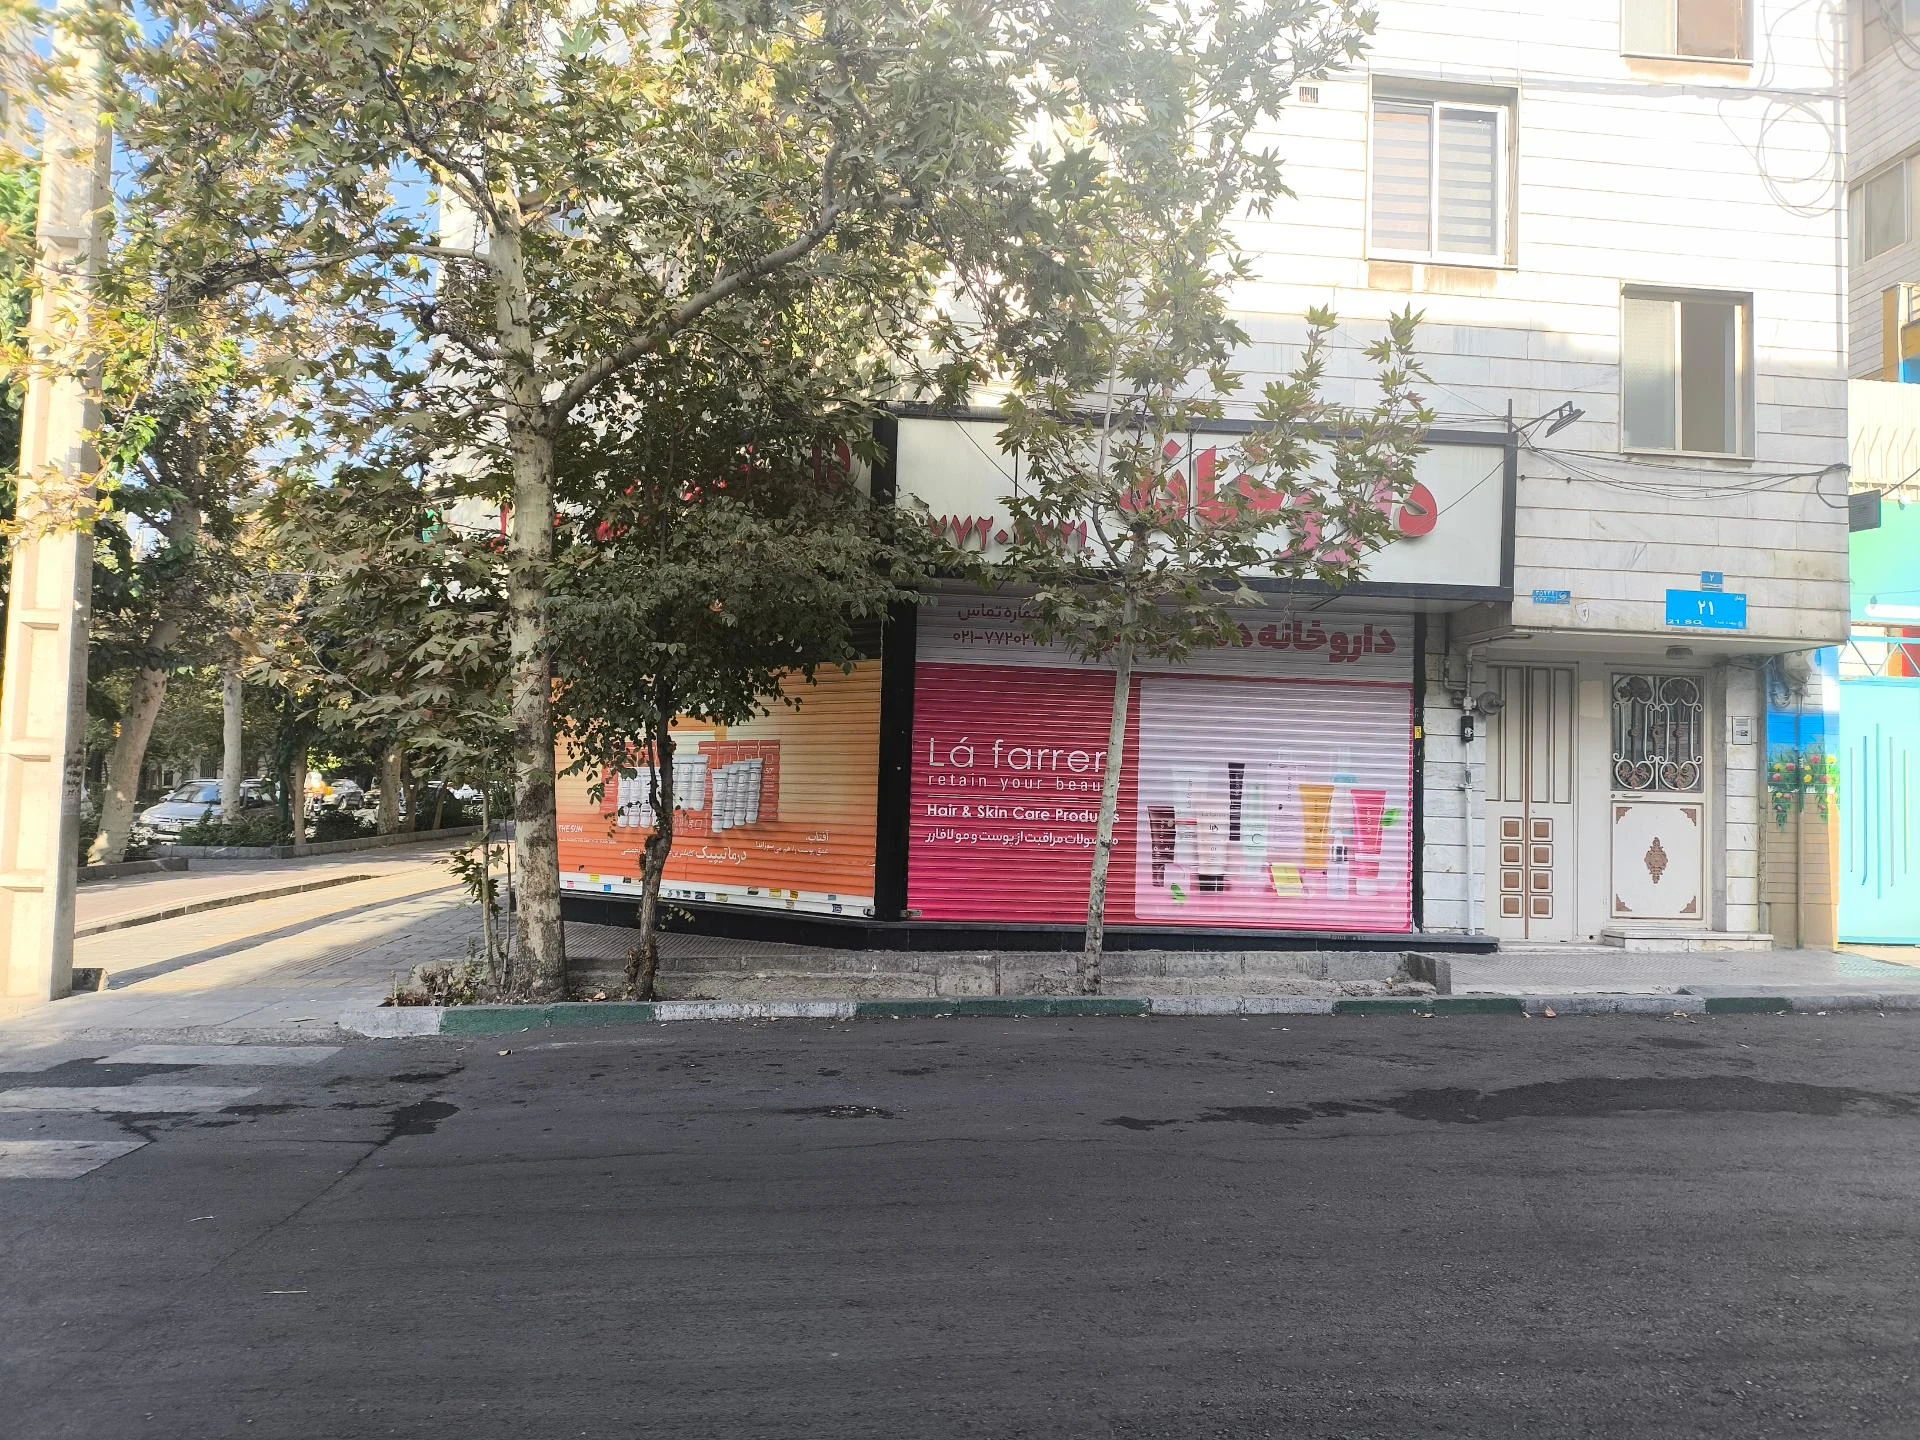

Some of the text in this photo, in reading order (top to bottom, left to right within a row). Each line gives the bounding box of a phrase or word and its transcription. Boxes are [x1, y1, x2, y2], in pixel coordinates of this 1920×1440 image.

[958, 604, 1002, 621] تماس
[1697, 599, 1714, 616] ۲۱
[953, 629, 1053, 647] ۰۲۱-۷۷۲۰۲۷۱
[1258, 618, 1397, 663] داروخانه
[929, 736, 975, 768] Lá
[928, 773, 1120, 793] retain your beau
[927, 803, 1120, 823] Hair & Skin Care Produs
[956, 831, 969, 844] مو
[971, 832, 977, 844] و
[979, 830, 1014, 846] پوست
[1015, 831, 1024, 845] از
[1025, 833, 1063, 847] مراقبت
